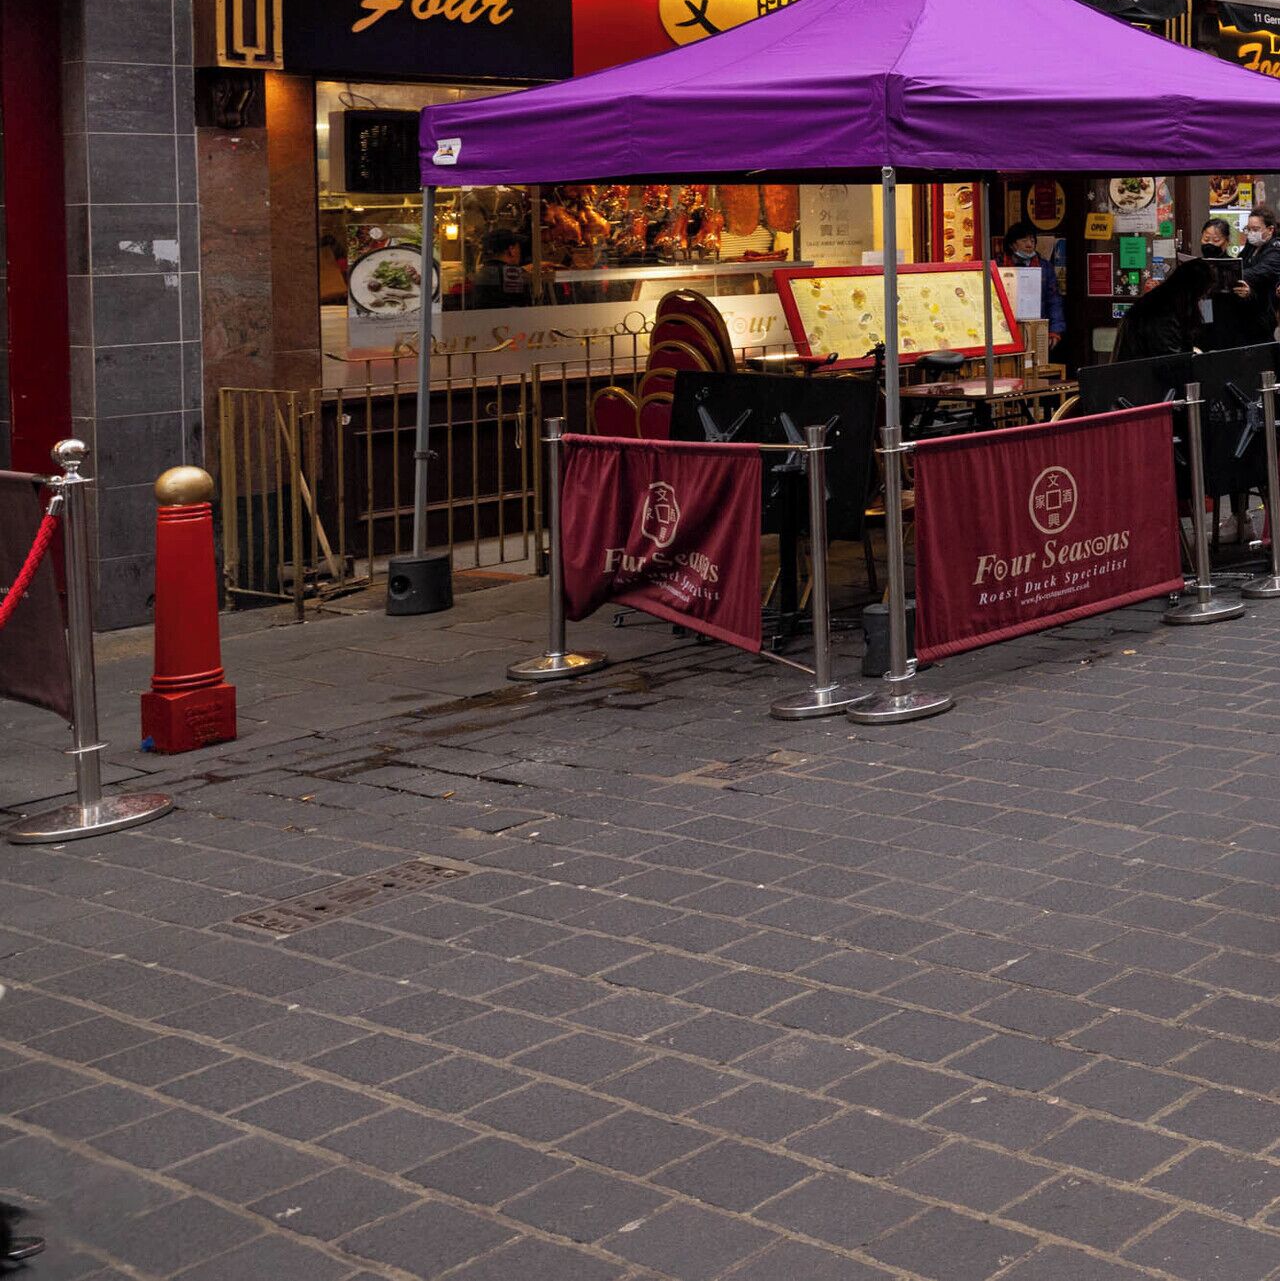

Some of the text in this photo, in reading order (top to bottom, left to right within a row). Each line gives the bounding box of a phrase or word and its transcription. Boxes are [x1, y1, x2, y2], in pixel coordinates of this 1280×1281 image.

[1253, 13, 1263, 22] 11
[1090, 223, 1108, 231] OPEN
[603, 547, 647, 573] Fur
[971, 529, 1130, 586] Four Seasons
[978, 558, 1128, 605] Roast Duck Specialist
